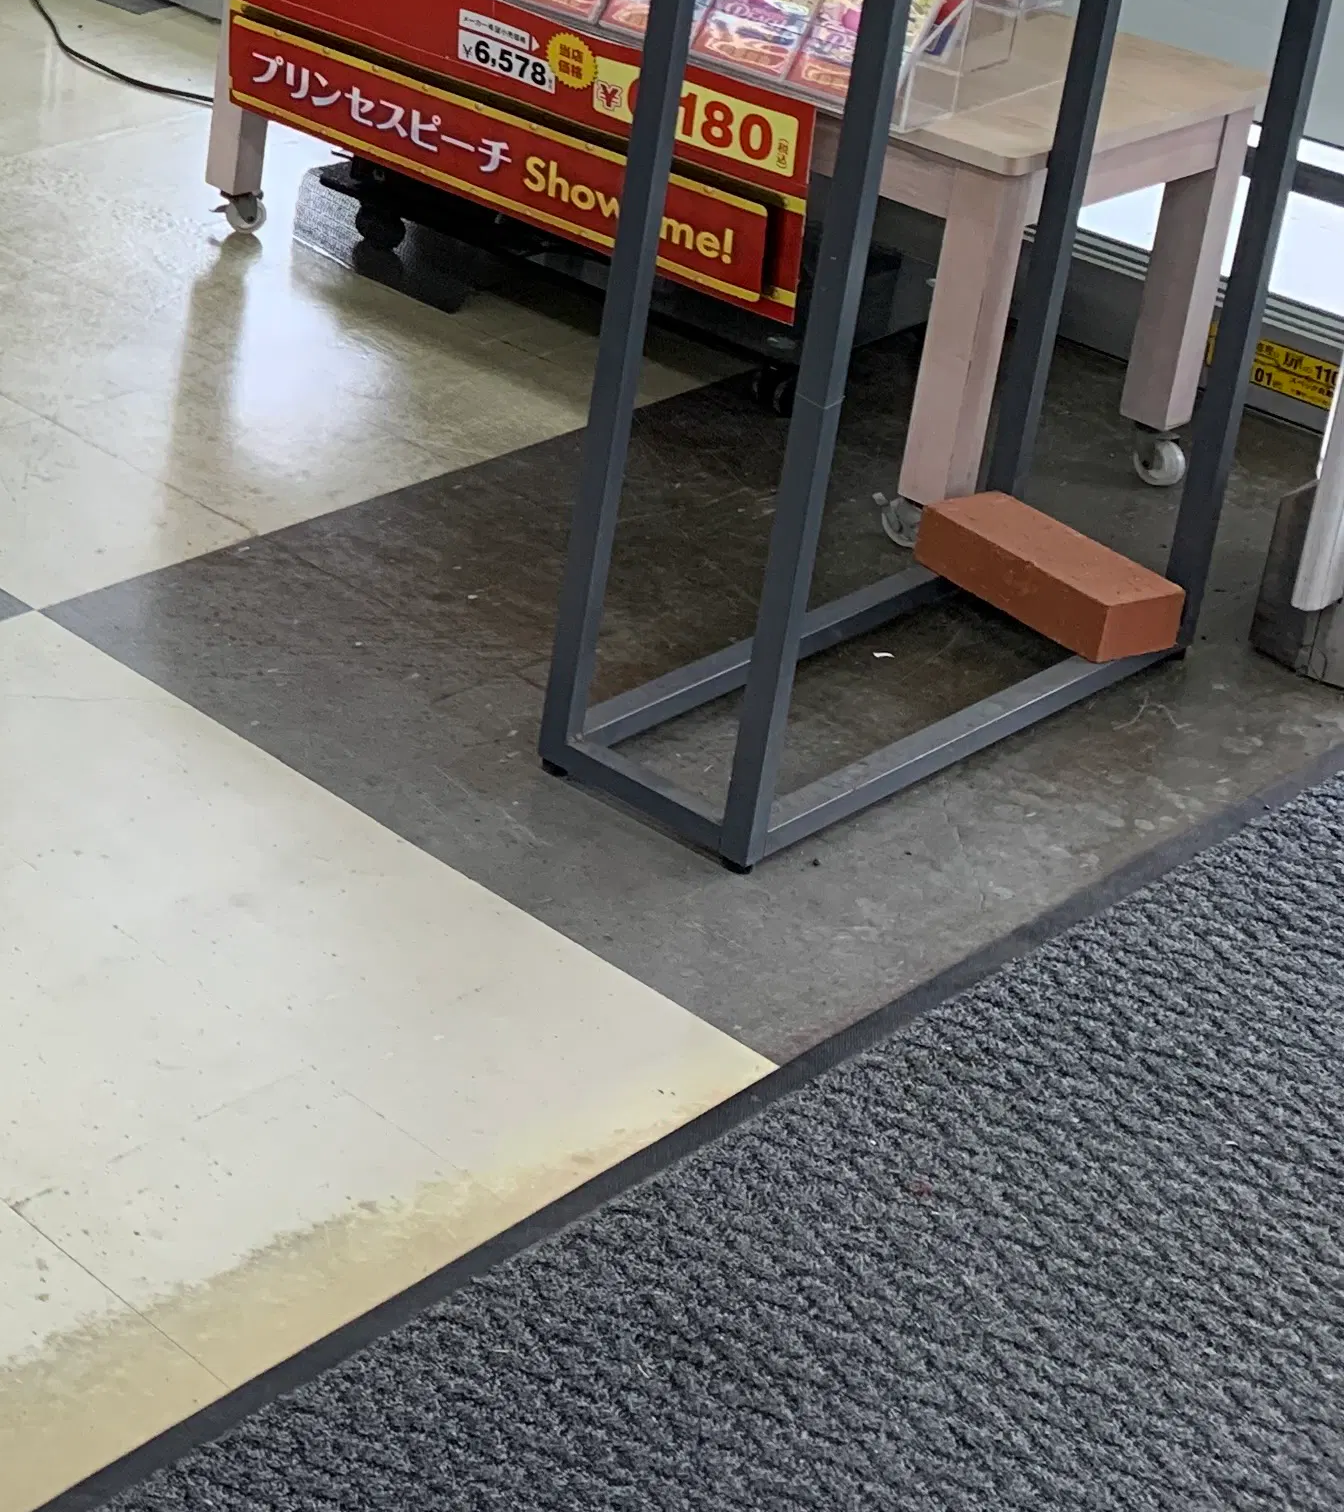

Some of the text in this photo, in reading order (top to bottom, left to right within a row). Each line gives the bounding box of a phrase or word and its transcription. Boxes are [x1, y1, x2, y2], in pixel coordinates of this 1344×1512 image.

[462, 40, 547, 87] ¥6,578
[558, 59, 583, 81] 価格
[559, 43, 584, 64] 当店
[251, 50, 734, 264] プリンセスピーチ Showme!
